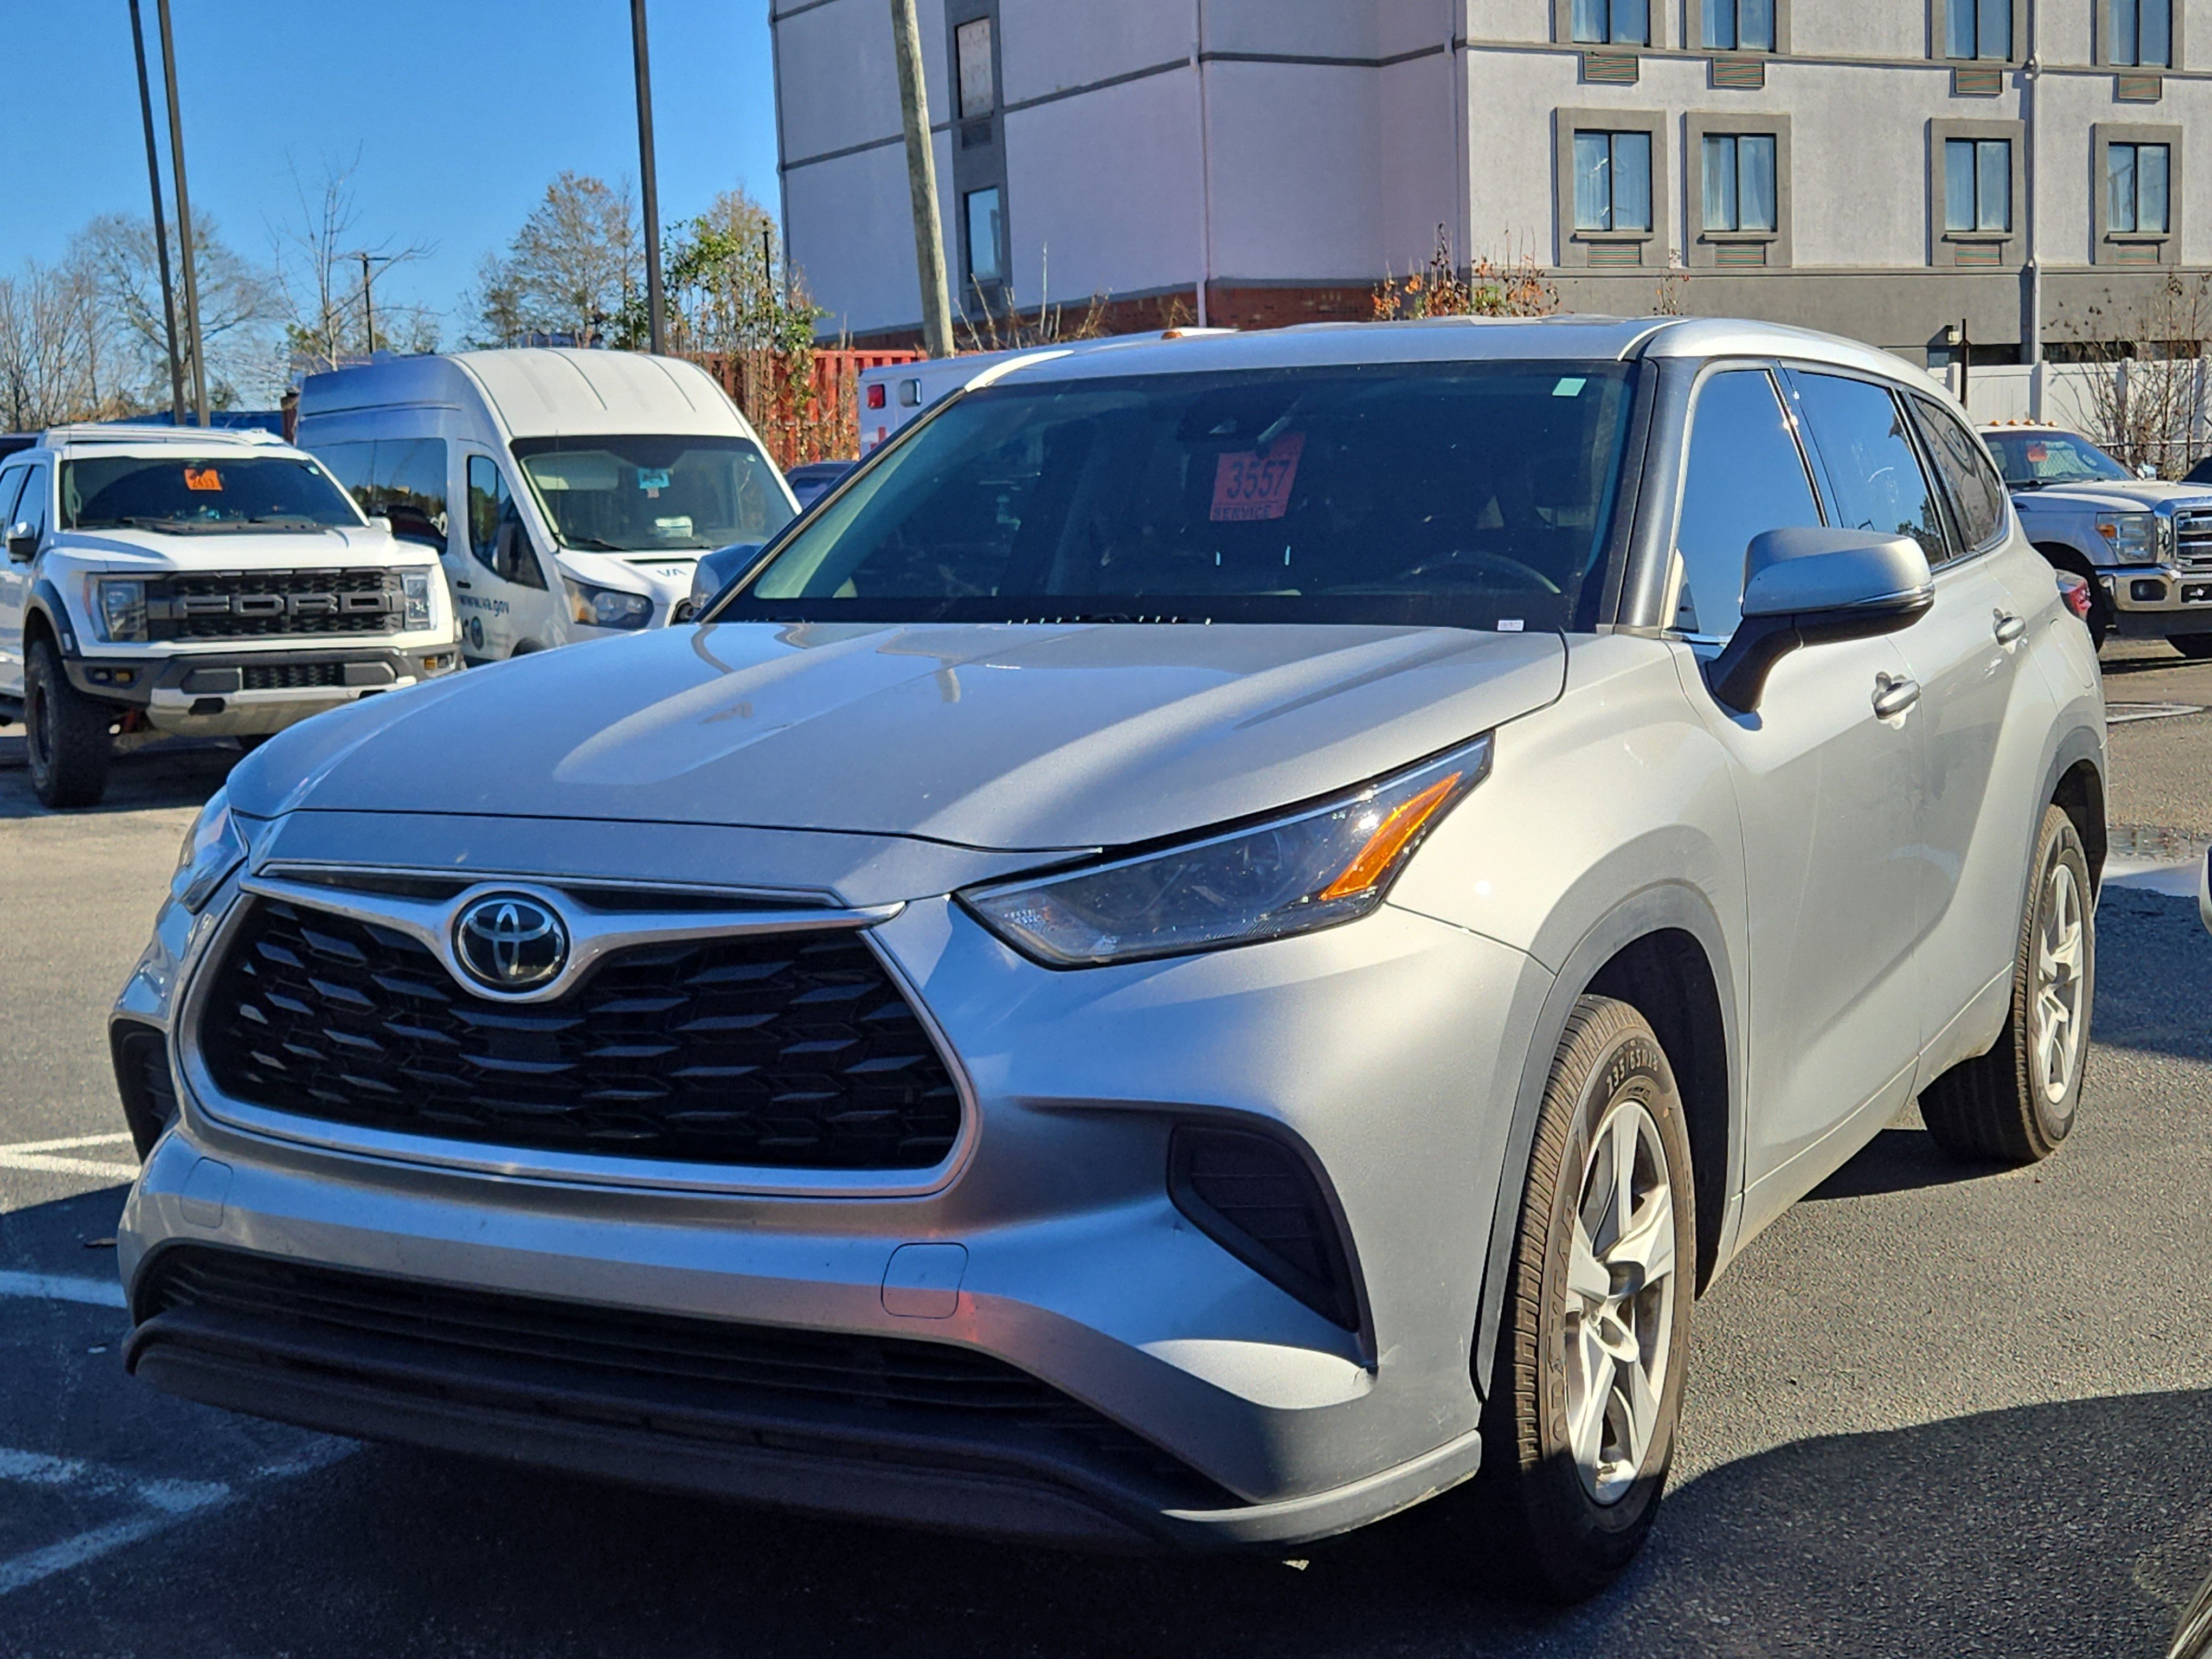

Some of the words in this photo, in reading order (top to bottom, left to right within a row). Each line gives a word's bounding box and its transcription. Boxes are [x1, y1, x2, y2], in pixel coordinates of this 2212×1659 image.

[1226, 459, 1291, 499] 3557
[656, 568, 687, 577] VA
[172, 592, 393, 619] FORD
